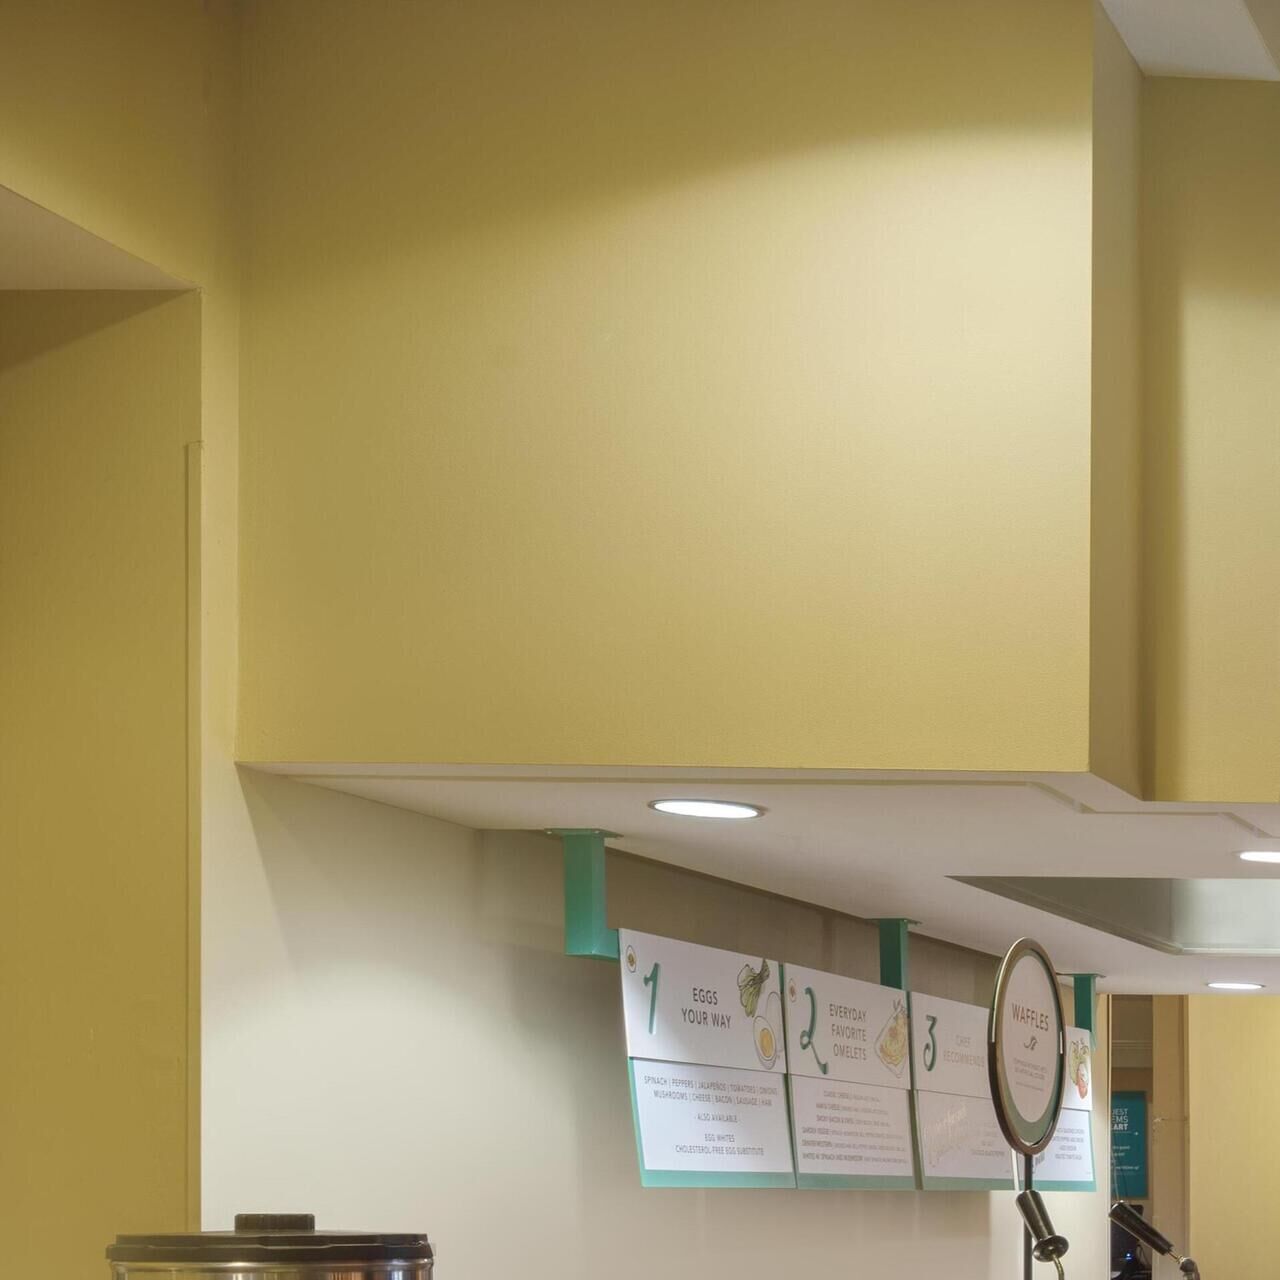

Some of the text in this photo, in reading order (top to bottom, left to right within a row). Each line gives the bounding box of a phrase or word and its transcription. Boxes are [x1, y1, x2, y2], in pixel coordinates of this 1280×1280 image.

[643, 962, 660, 1035] 1
[692, 987, 718, 1006] EGGS
[681, 1007, 732, 1029] YOUR WAY
[829, 1003, 867, 1023] EVERYDAY
[1012, 1002, 1049, 1032] WAFFLES
[800, 986, 828, 1075] 2
[831, 1023, 867, 1042] FAVORITE
[923, 1014, 937, 1072] 3
[833, 1045, 867, 1061] OMELETS
[943, 1050, 985, 1068] RECOMMENDS
[644, 1075, 668, 1086] SPINACH
[672, 1078, 694, 1089] PEPPERS
[653, 1090, 688, 1101] MUSHROOMS
[692, 1093, 711, 1103] CHEESE
